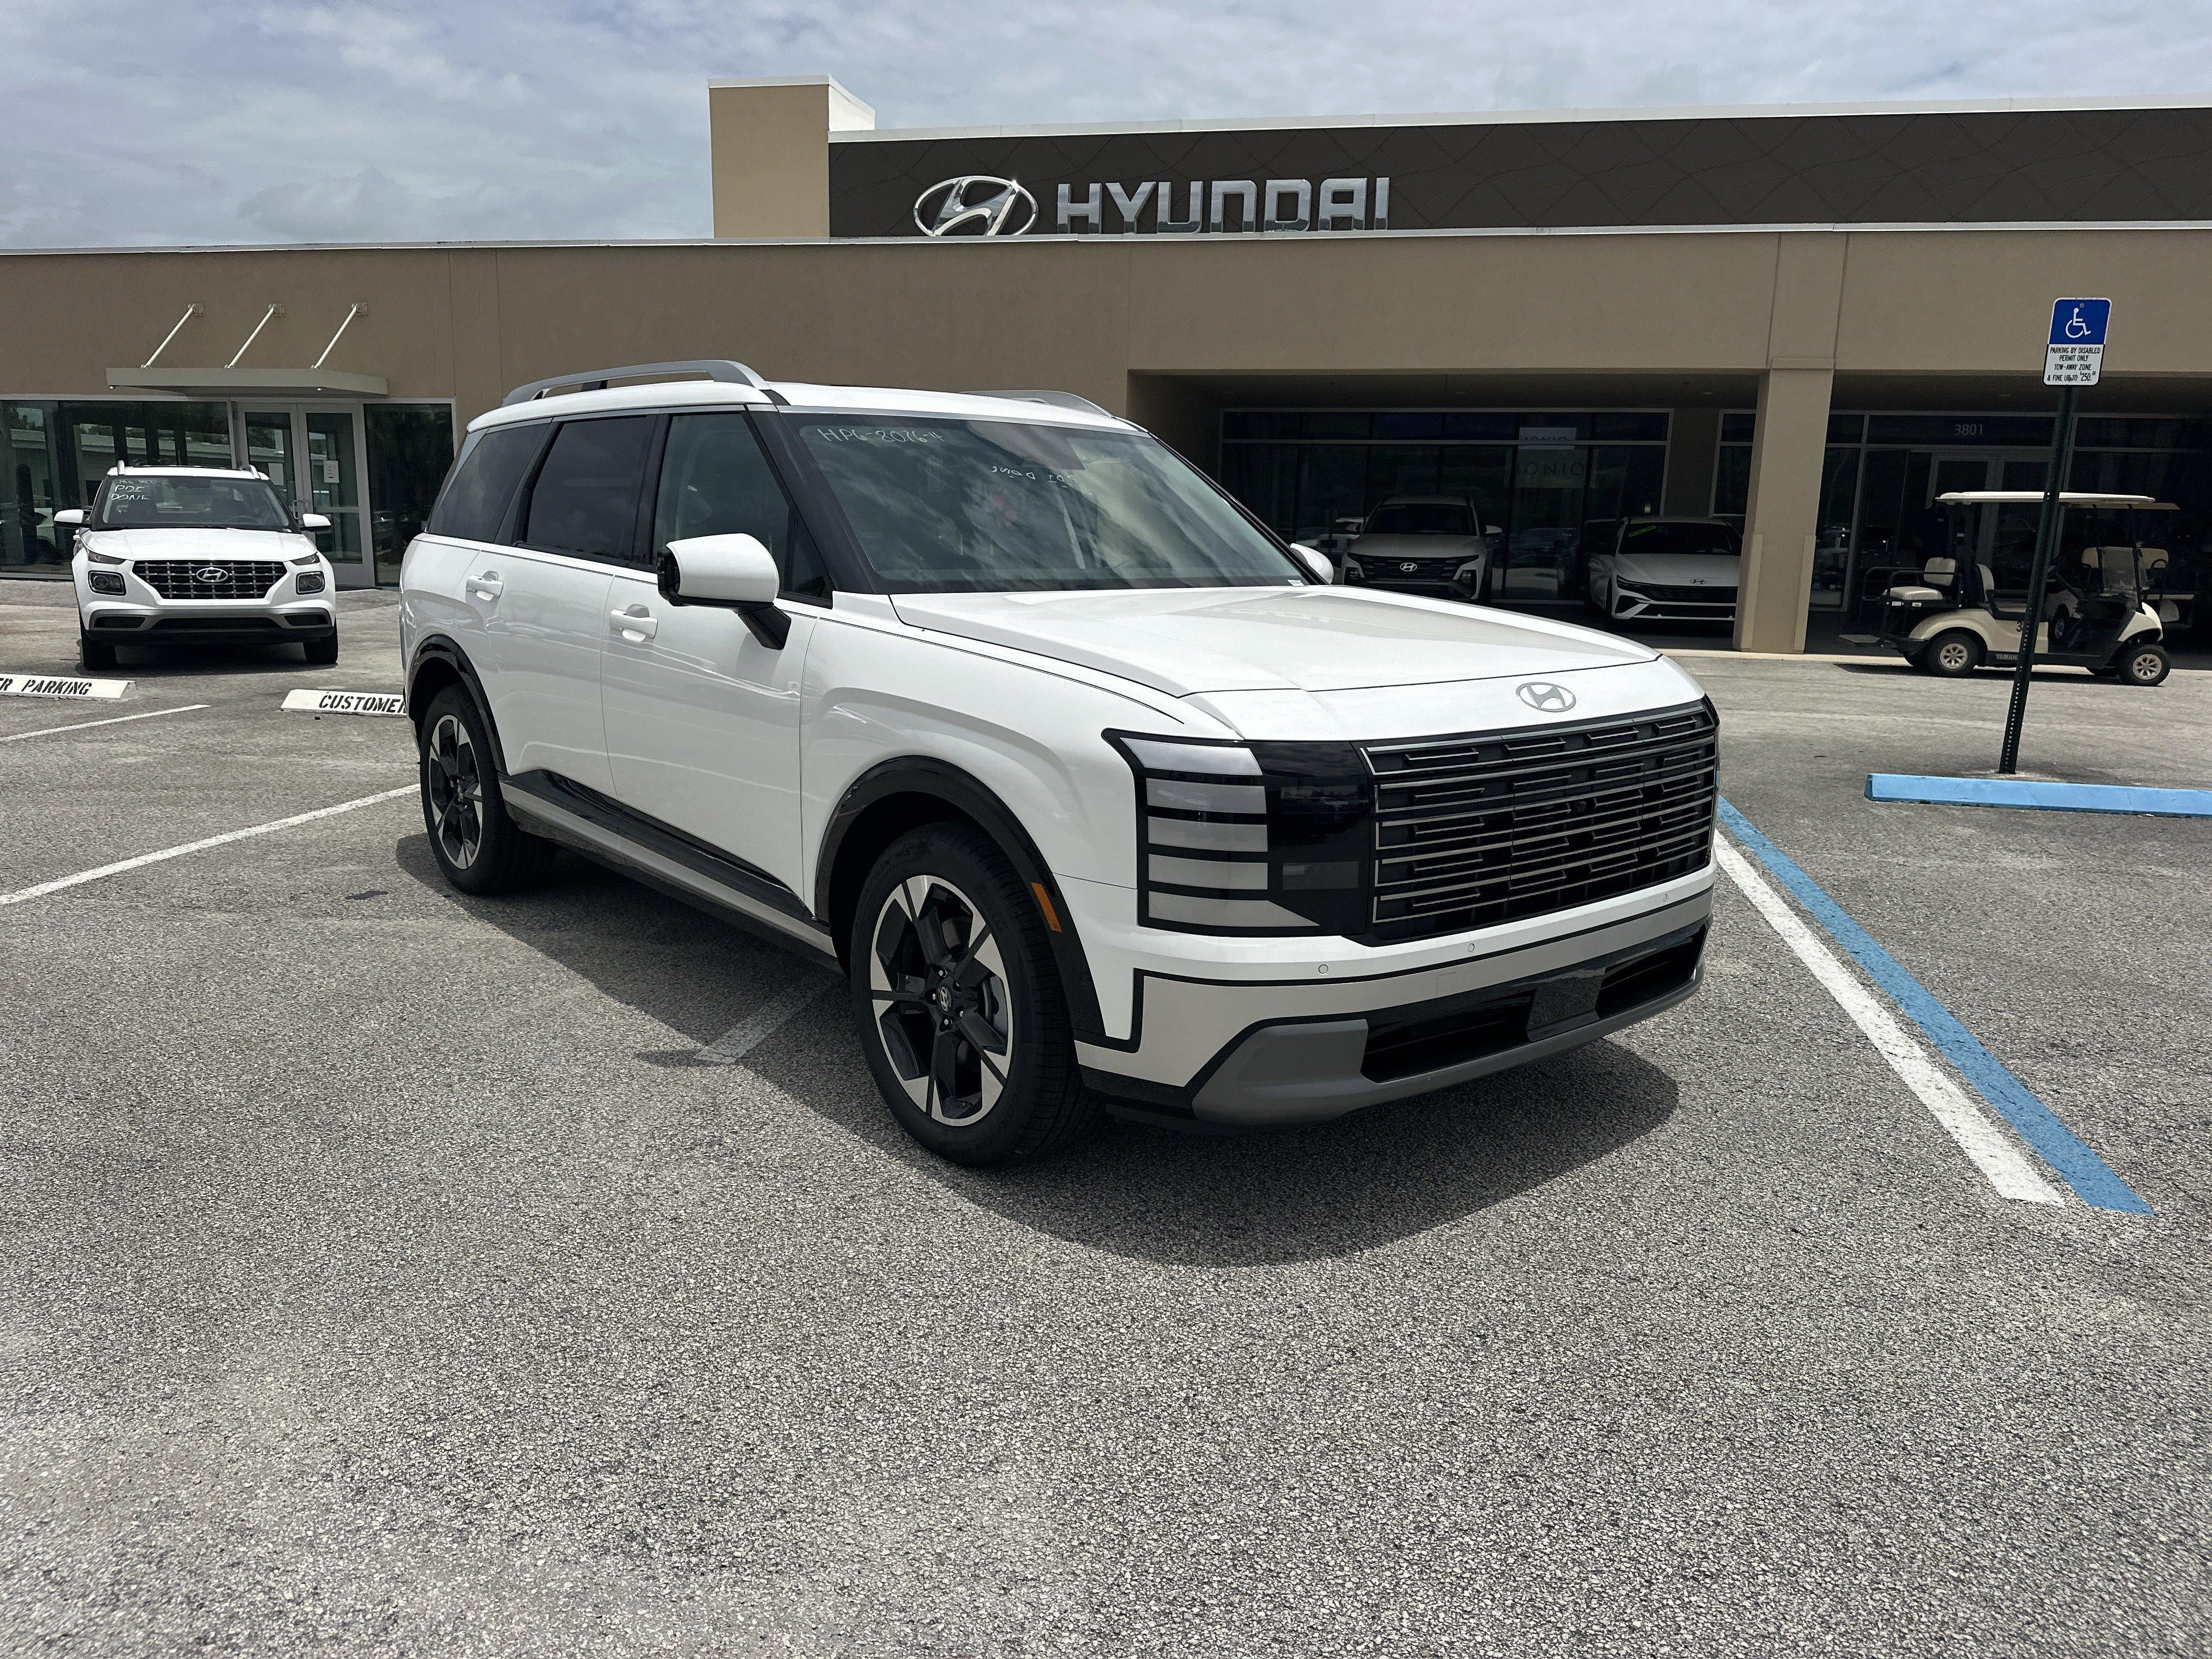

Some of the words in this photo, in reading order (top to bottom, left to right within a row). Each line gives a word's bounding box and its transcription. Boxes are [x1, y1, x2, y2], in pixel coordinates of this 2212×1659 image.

[1057, 177, 1390, 234] HYUNDAI
[1954, 423, 1983, 436] 3801
[114, 484, 145, 493] PDI
[21, 679, 92, 695] PARKING
